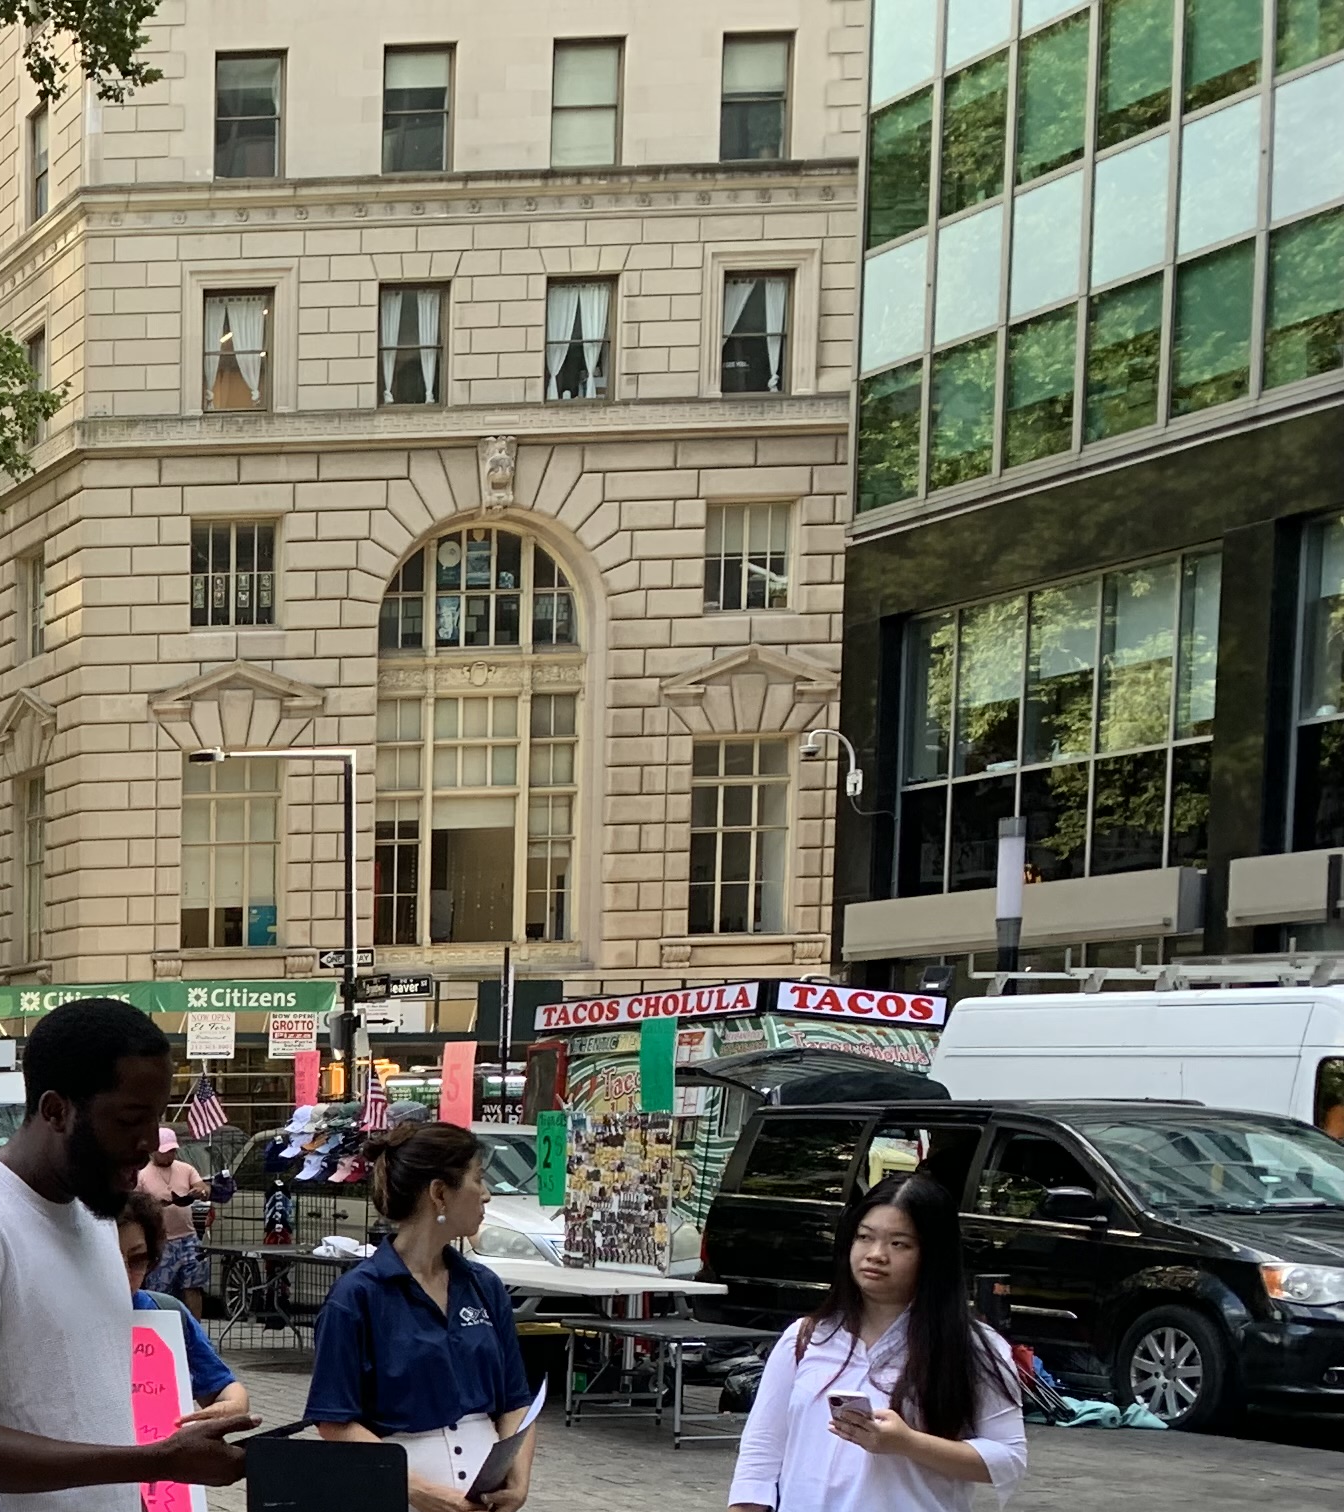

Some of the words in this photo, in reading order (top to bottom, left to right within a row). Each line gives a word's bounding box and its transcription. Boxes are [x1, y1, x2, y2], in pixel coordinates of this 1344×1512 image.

[356, 953, 370, 962] AY
[390, 983, 419, 994] eaver
[211, 988, 297, 1007] Citizens
[790, 985, 934, 1020] TACOS
[543, 1000, 620, 1027] TACOS
[626, 986, 751, 1019] CHOLULA
[272, 1020, 314, 1031] GROTTO
[446, 1063, 462, 1103] 5
[133, 1344, 155, 1357] AD
